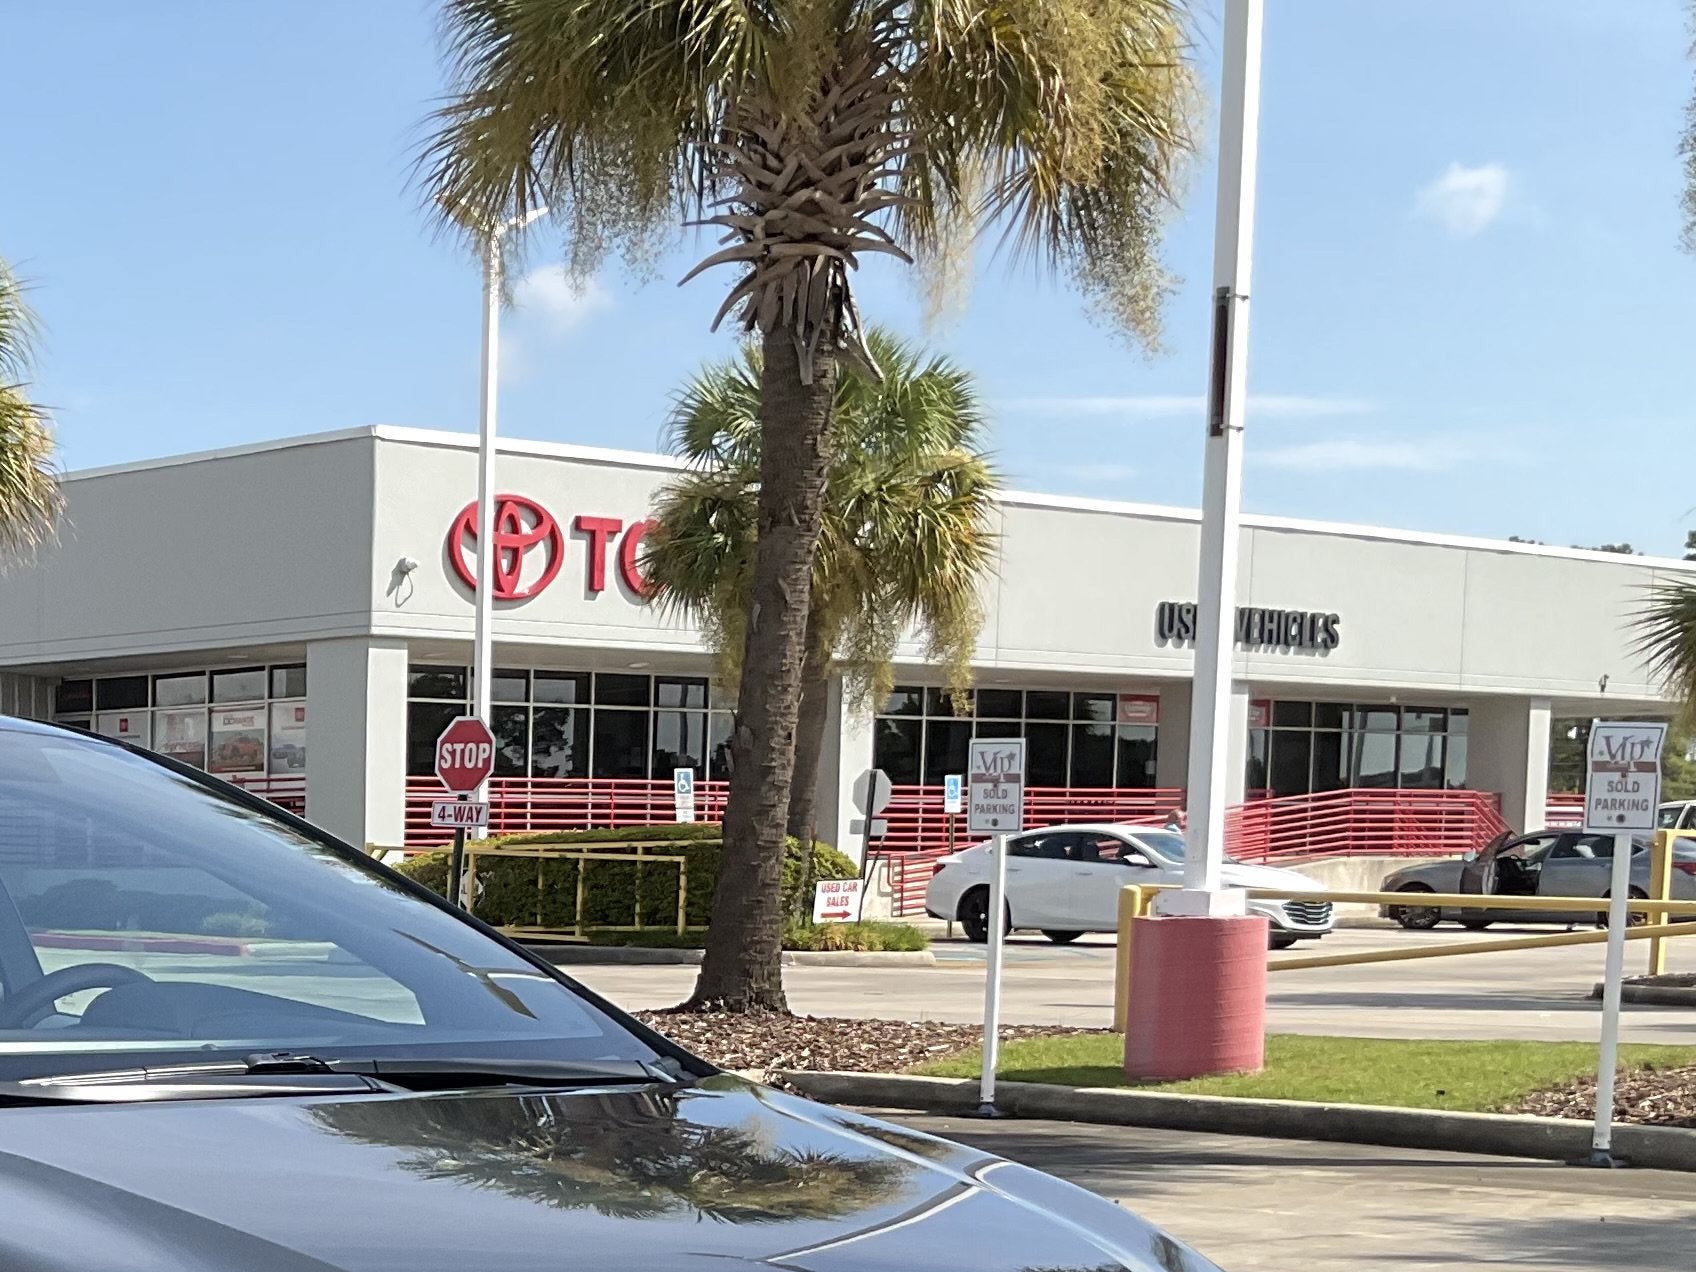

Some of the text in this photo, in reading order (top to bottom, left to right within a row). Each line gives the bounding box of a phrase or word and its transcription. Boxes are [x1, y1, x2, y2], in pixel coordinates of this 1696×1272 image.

[1157, 601, 1340, 650] US VEHICLES
[440, 742, 491, 769] STOP
[1607, 780, 1640, 793] SOLD
[983, 788, 1008, 799] SOLD
[974, 803, 1015, 815] PARKING
[1594, 798, 1649, 812] PARKING
[437, 805, 484, 824] 4-WAY
[821, 881, 858, 894] USED CAR
[826, 895, 850, 907] SALES
